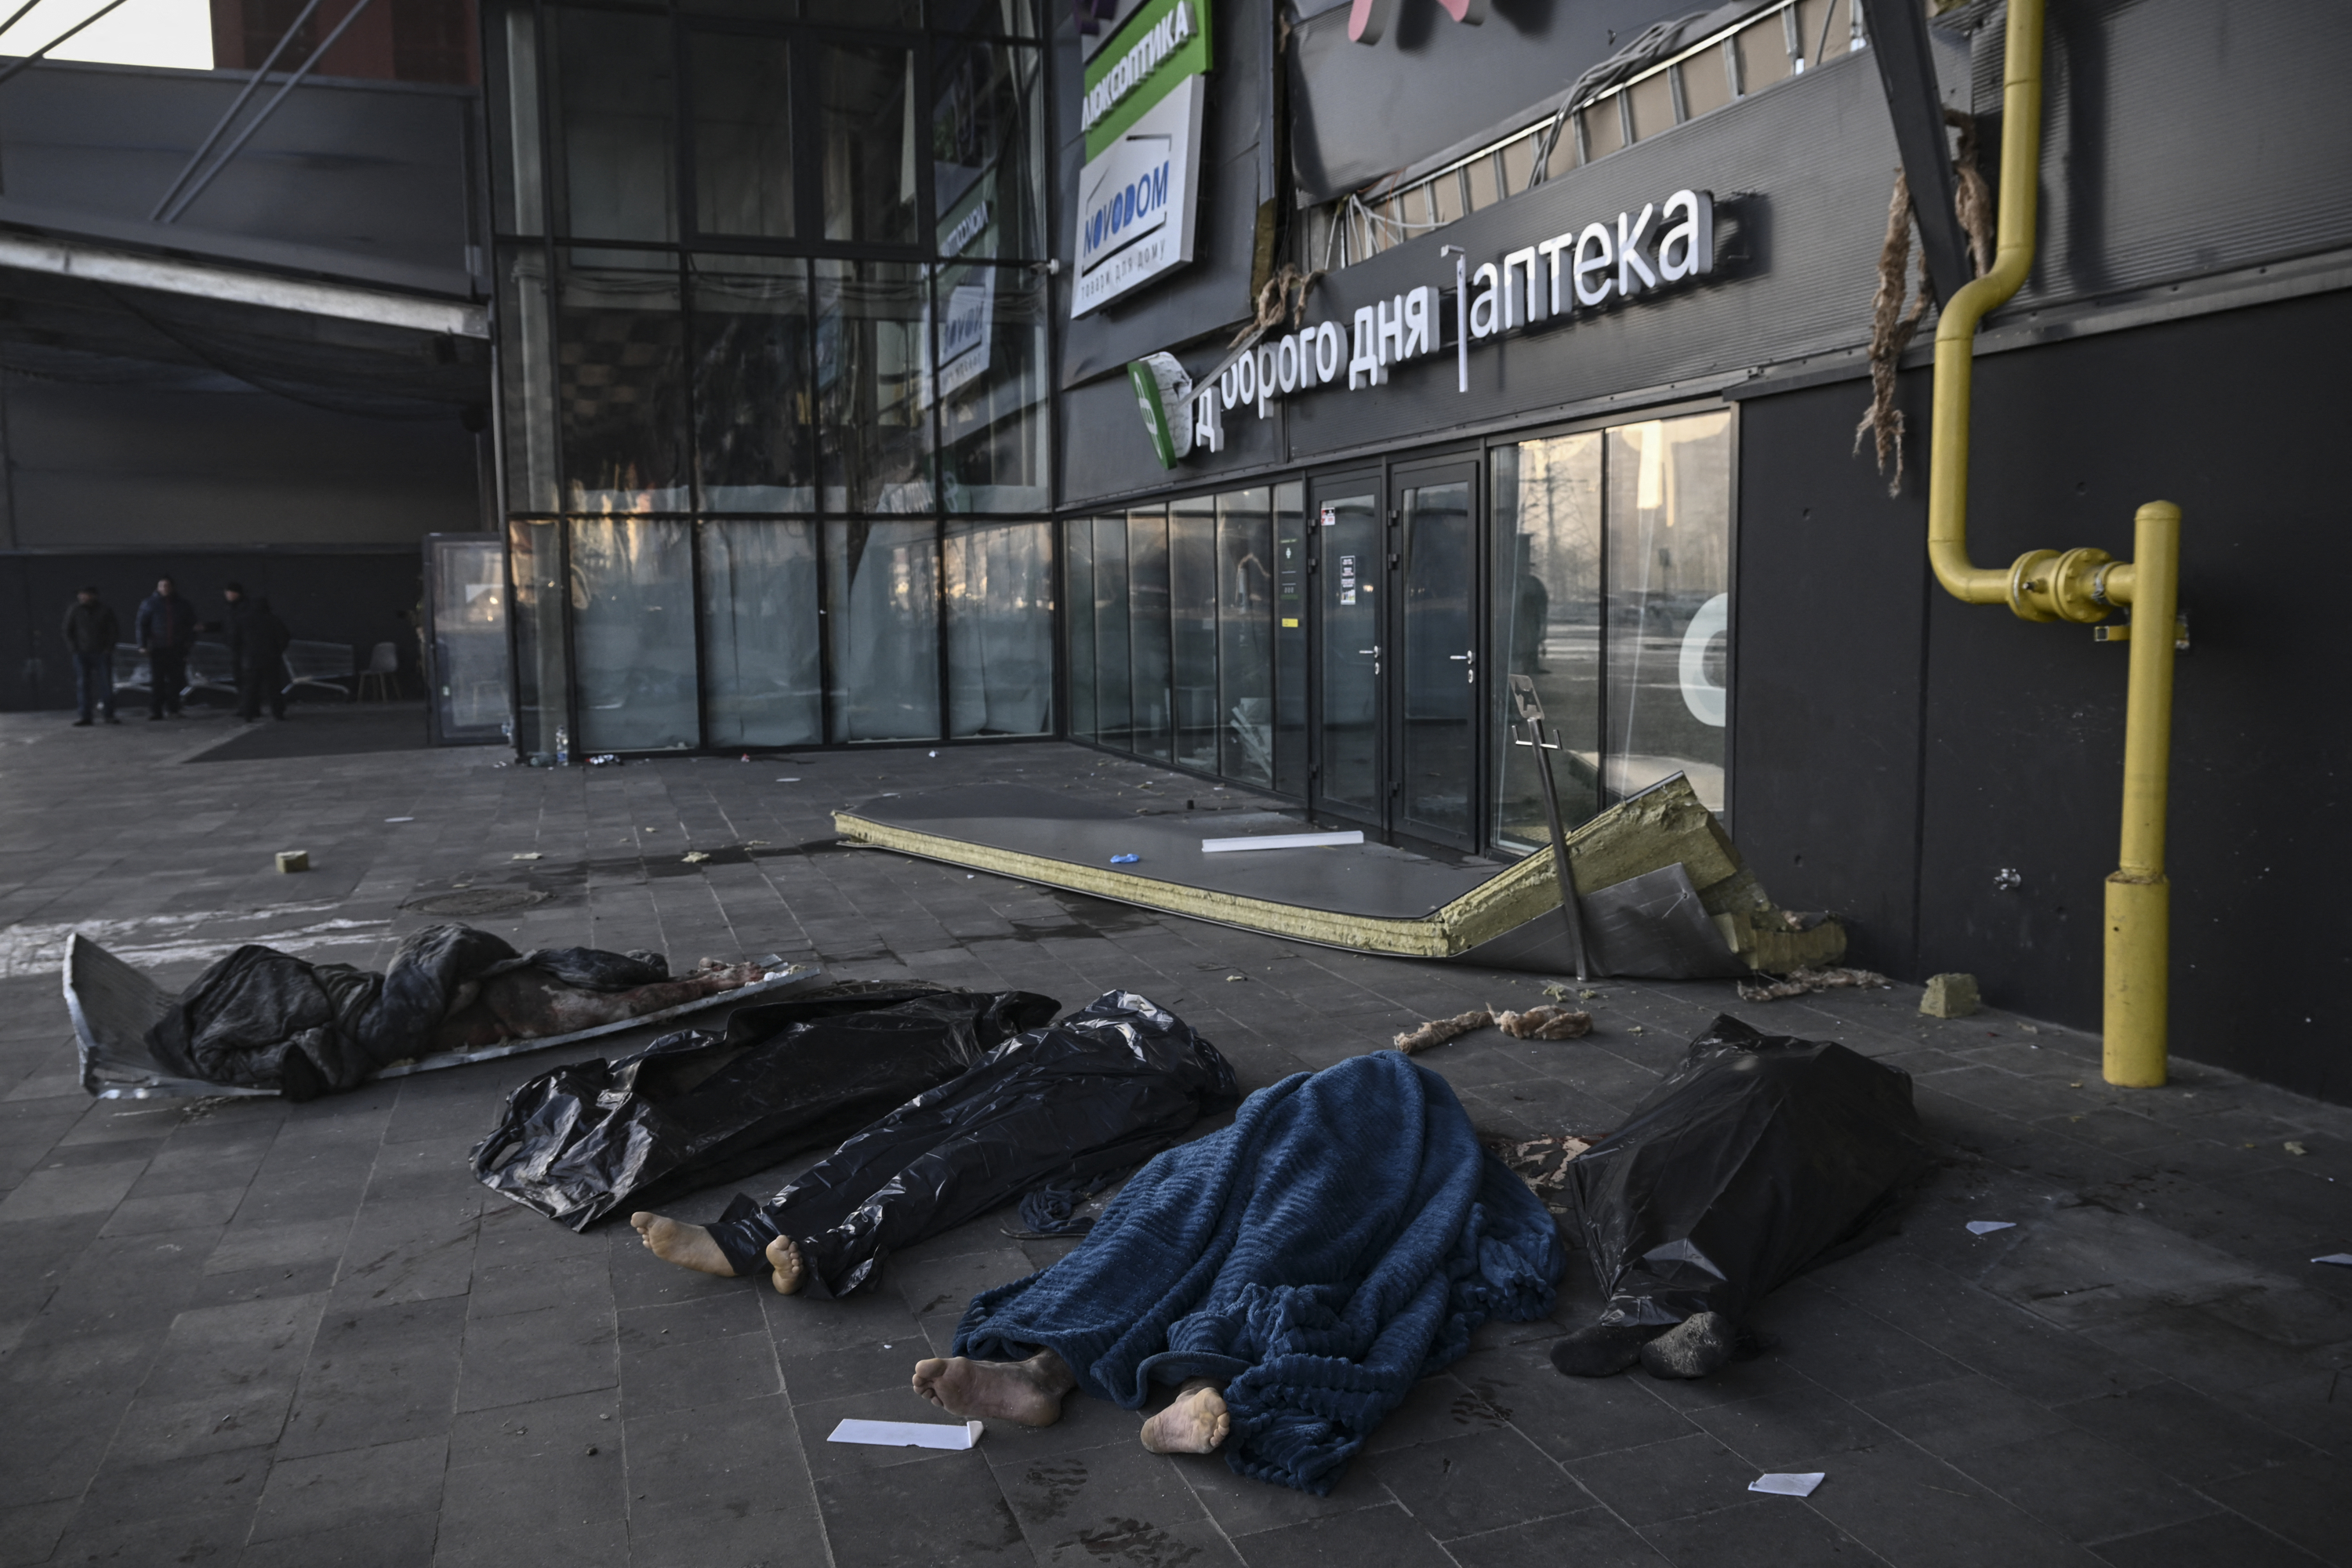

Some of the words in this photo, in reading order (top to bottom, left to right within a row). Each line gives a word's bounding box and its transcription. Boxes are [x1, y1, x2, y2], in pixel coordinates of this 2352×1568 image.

[1083, 160, 1169, 258] NOVODOM
[1349, 286, 1429, 390] дня
[1470, 190, 1700, 338] аптека
